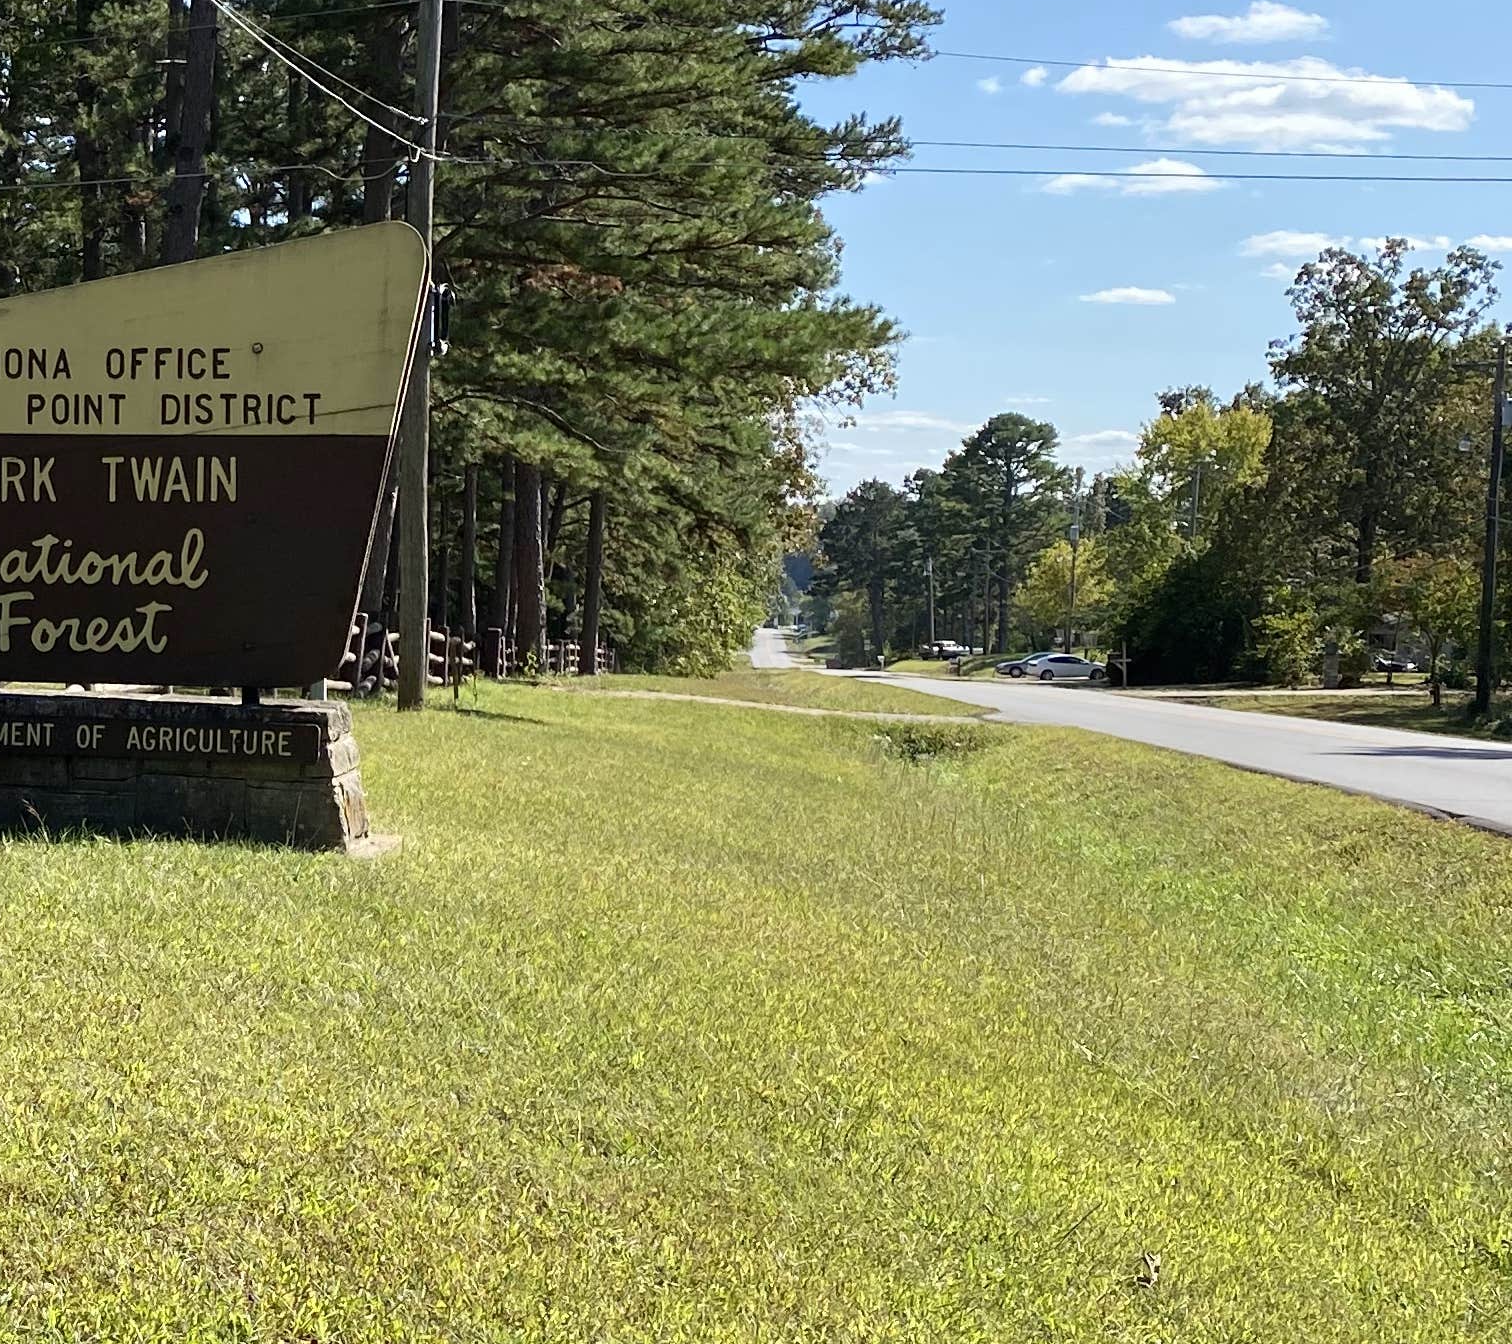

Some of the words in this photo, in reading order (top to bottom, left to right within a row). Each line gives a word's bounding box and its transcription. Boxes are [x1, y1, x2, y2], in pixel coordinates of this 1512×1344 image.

[106, 346, 231, 379] OFFICE
[26, 393, 126, 426] POINT
[160, 393, 323, 426] DISTRICT
[102, 456, 238, 503] TWAIN
[76, 723, 106, 750] OF
[126, 726, 293, 757] AGRICULTURE
